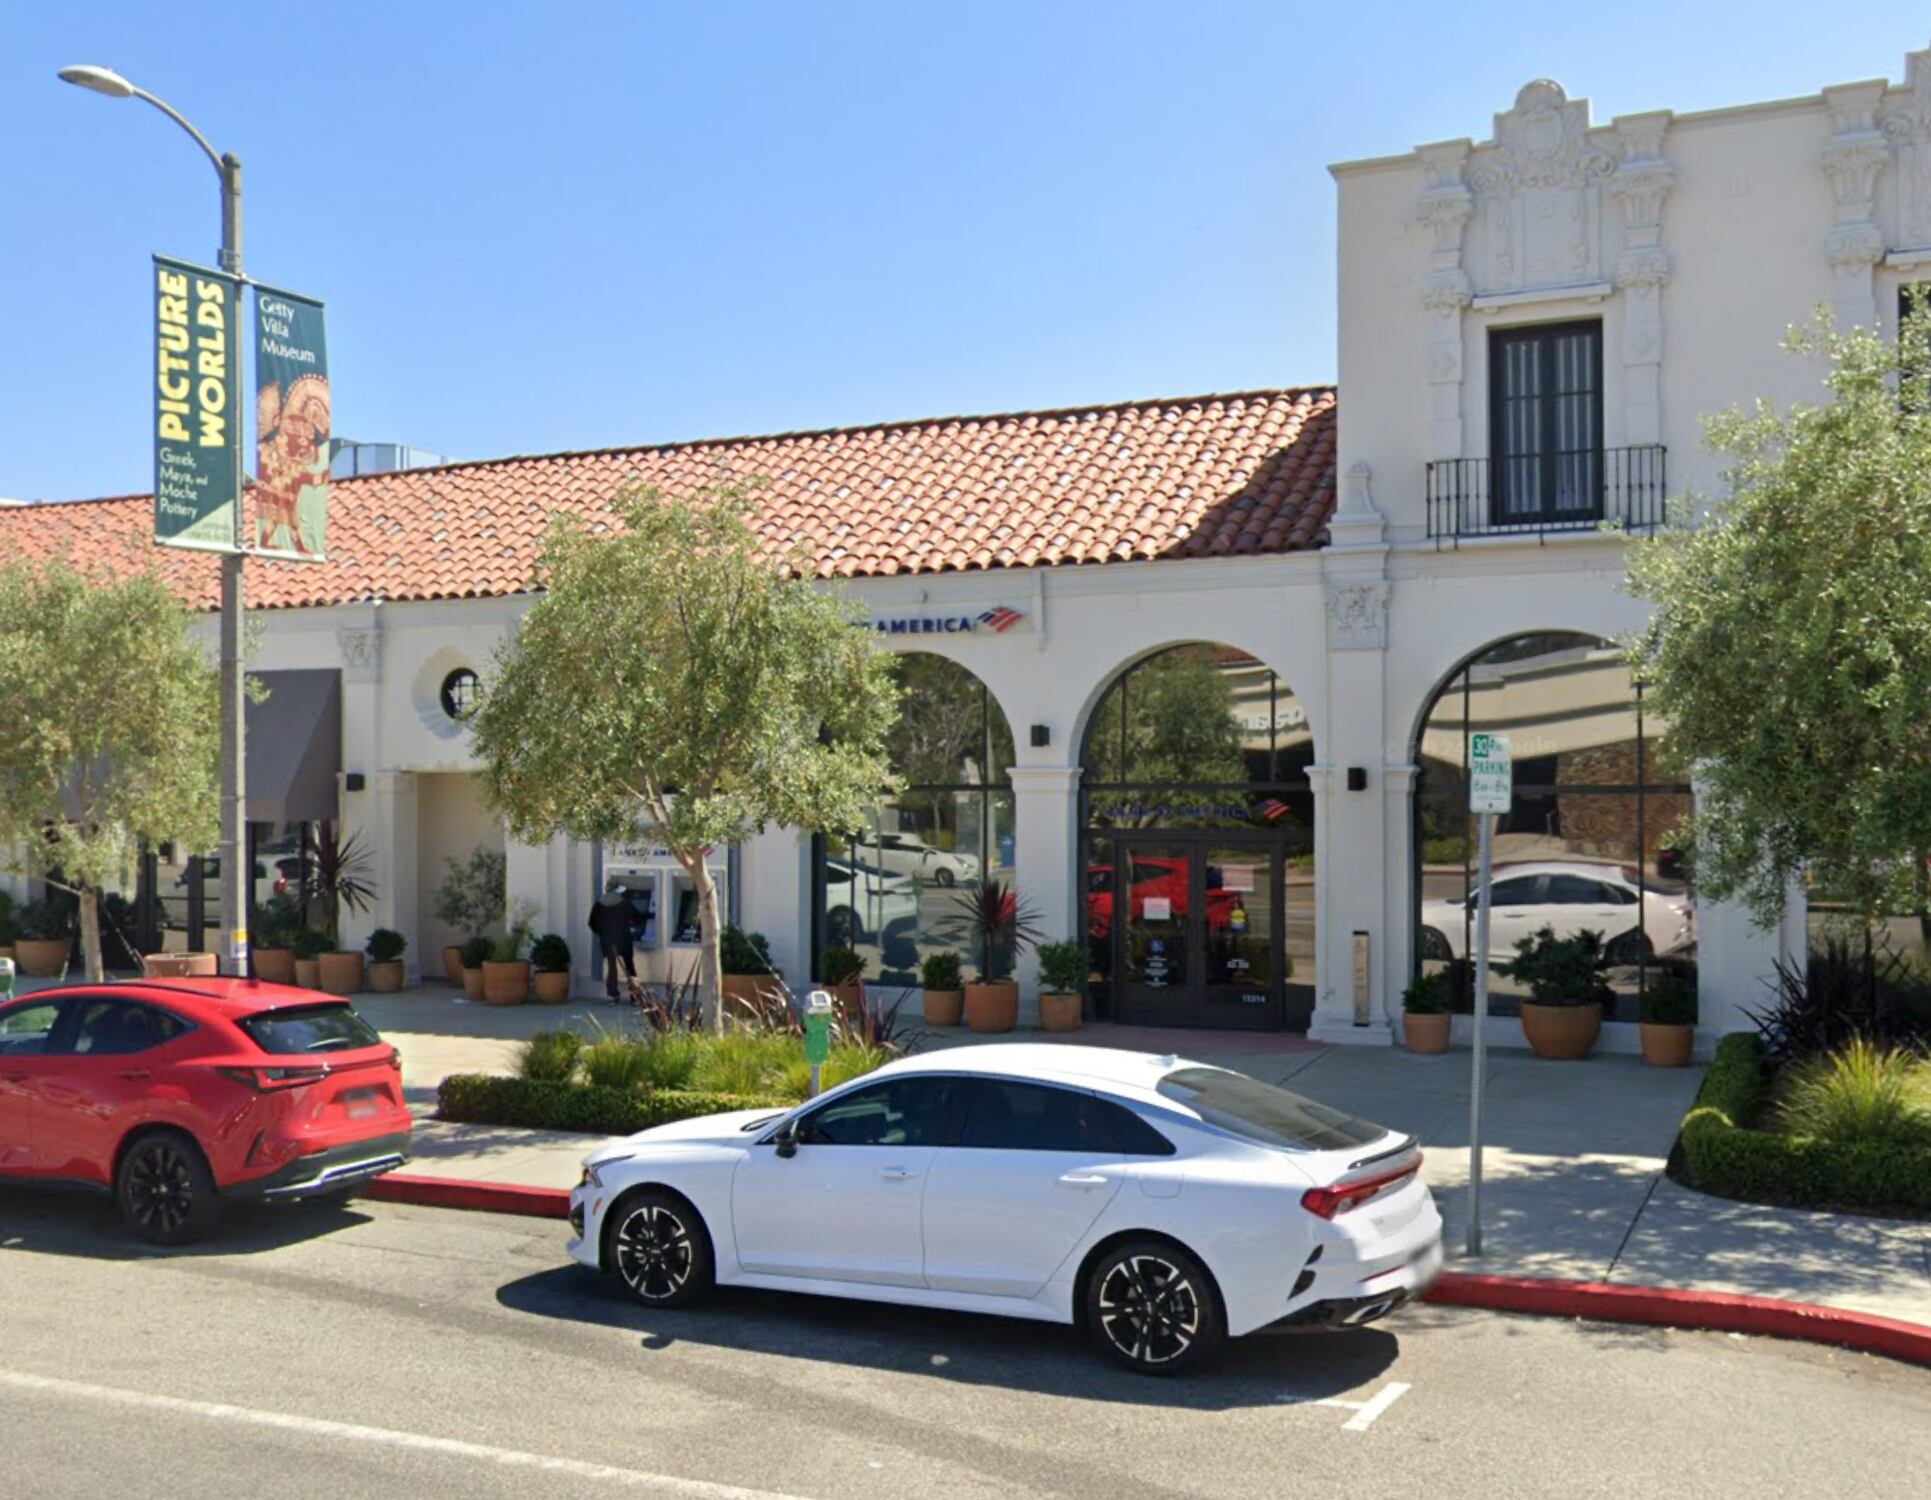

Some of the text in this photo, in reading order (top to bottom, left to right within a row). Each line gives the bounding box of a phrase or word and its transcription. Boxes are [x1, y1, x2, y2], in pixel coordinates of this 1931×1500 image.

[259, 296, 295, 322] Getty
[261, 316, 290, 339] Villa
[158, 269, 190, 442] PICTURE
[261, 337, 315, 364] Museum
[196, 279, 225, 447] WORLDS
[160, 447, 197, 469] Greek,
[160, 482, 198, 500] Moche
[160, 497, 198, 520] Pottery
[877, 617, 972, 634] AMERICA
